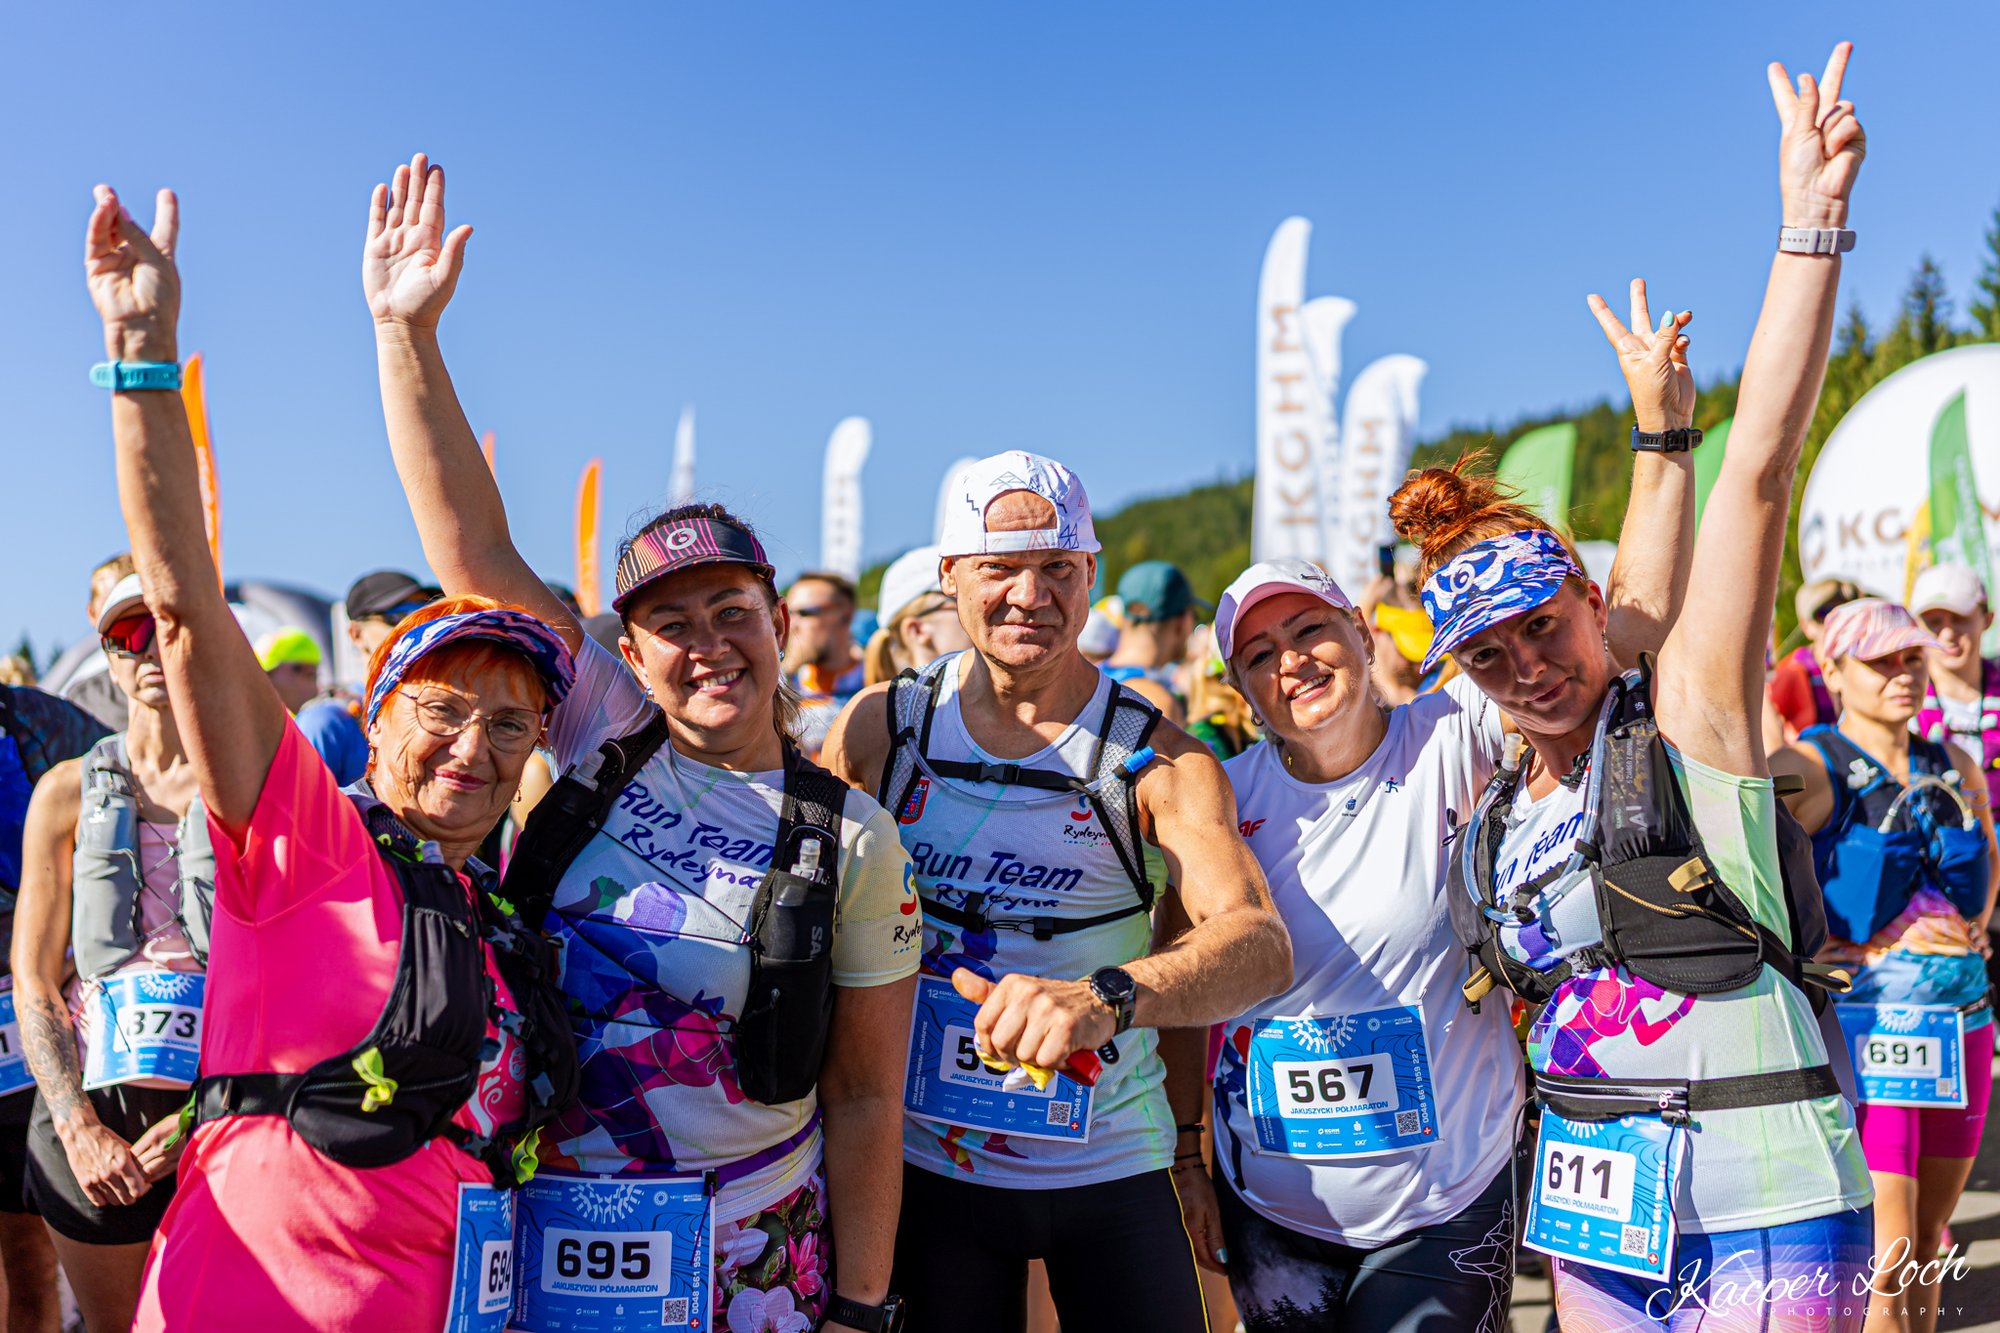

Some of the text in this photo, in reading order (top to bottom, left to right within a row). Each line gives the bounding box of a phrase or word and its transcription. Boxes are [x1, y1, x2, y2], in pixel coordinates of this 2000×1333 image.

[620, 781, 682, 829] Run
[1063, 824, 1108, 841] Rydzyn
[620, 823, 761, 889] Rydzyna
[911, 842, 1084, 892] Run Team
[1869, 1042, 1927, 1066] 691
[950, 1073, 993, 1087] JAKUSZYCKI
[1288, 1063, 1374, 1104] 567
[1411, 1048, 1430, 1124] 0048 661 959 221
[1073, 1098, 1082, 1119] 0048
[1290, 1107, 1334, 1115] JAKUSZYCKI
[1549, 1150, 1612, 1200] 611
[525, 1187, 536, 1198] 12
[557, 1238, 650, 1280] 695
[489, 1250, 512, 1293] 694
[692, 1271, 700, 1288] 661
[552, 1281, 658, 1293] JAKUSZYCKI PÓŁMARATON
[691, 1291, 700, 1315] 0048
